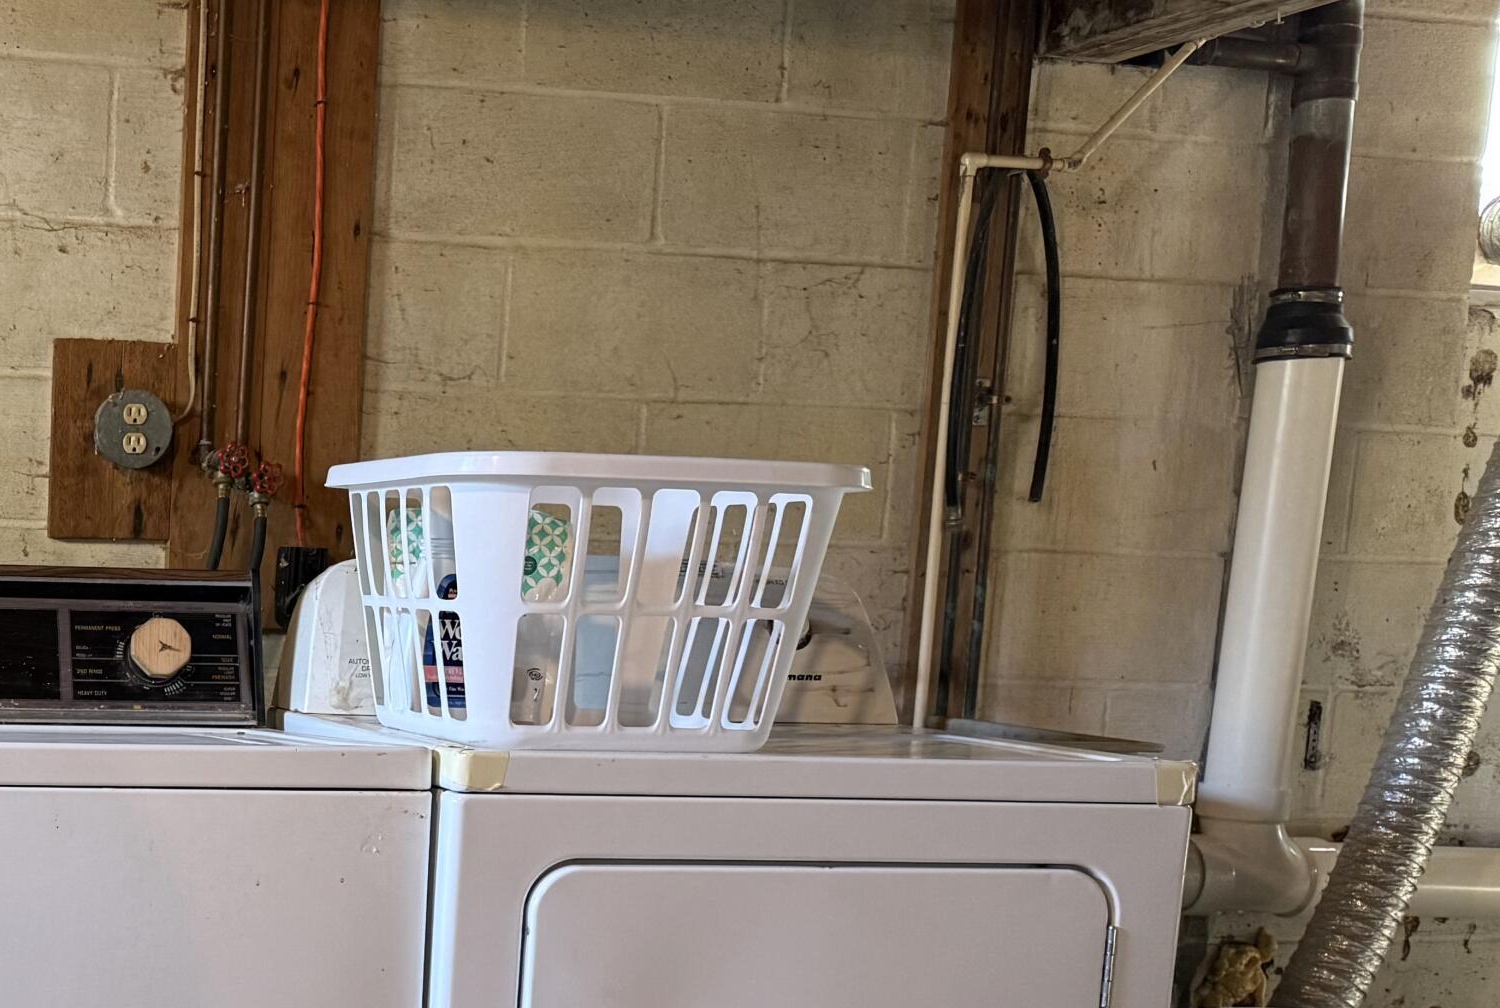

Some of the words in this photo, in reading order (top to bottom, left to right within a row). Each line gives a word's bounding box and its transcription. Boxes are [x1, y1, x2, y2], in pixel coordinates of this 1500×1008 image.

[439, 619, 462, 640] Wo
[441, 640, 464, 661] Wa
[788, 674, 822, 682] mana
